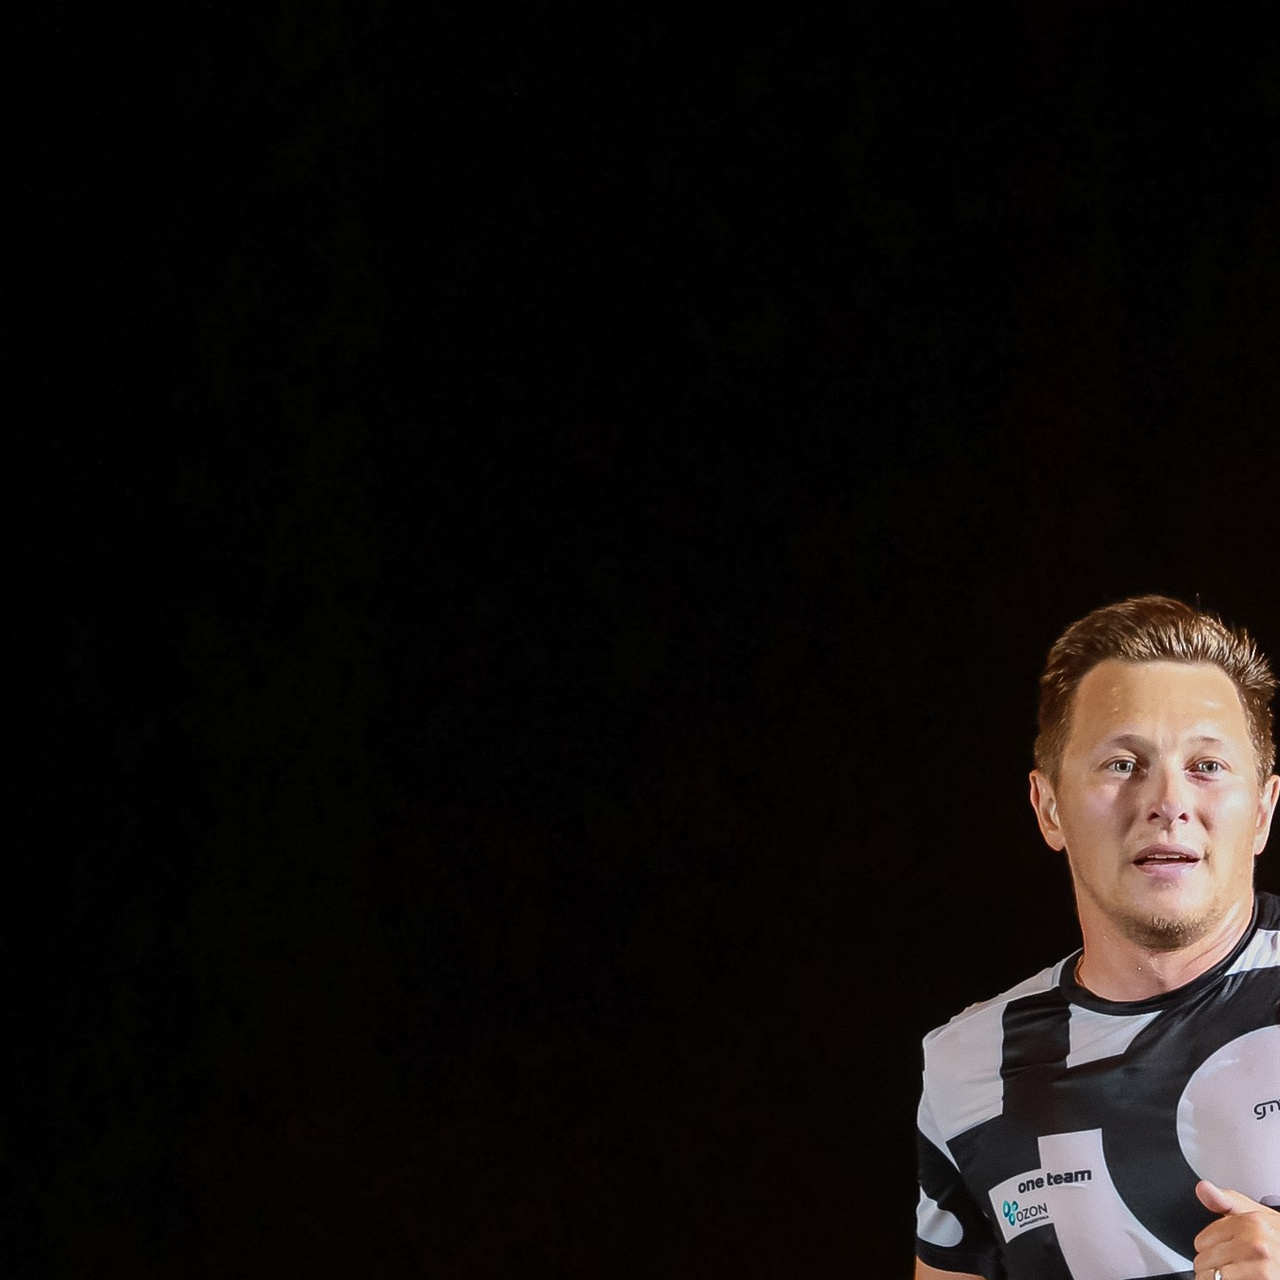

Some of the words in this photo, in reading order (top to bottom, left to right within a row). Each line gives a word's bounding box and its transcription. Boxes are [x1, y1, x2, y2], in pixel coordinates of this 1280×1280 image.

[1018, 1177, 1044, 1193] one
[1046, 1169, 1092, 1186] team
[1016, 1202, 1048, 1222] OZON
